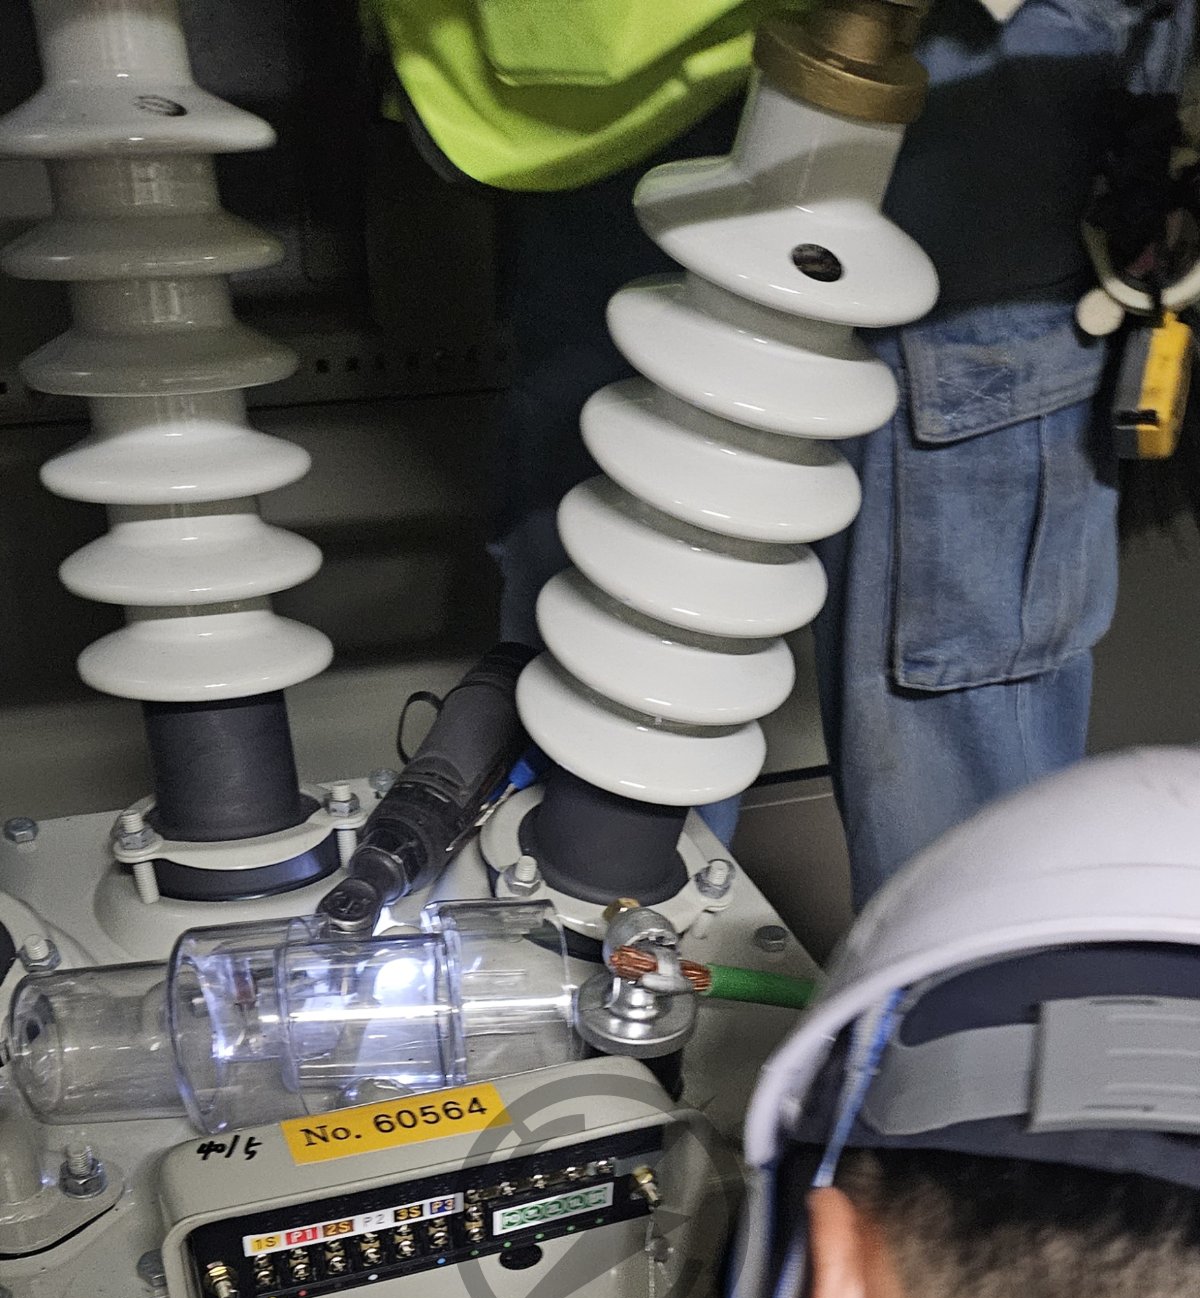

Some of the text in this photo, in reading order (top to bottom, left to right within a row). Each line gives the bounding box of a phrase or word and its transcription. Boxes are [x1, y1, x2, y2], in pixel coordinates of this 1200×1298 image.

[301, 1096, 488, 1147] No. 60564
[255, 1198, 456, 1250] 1S P1 2S P2 3S P3
